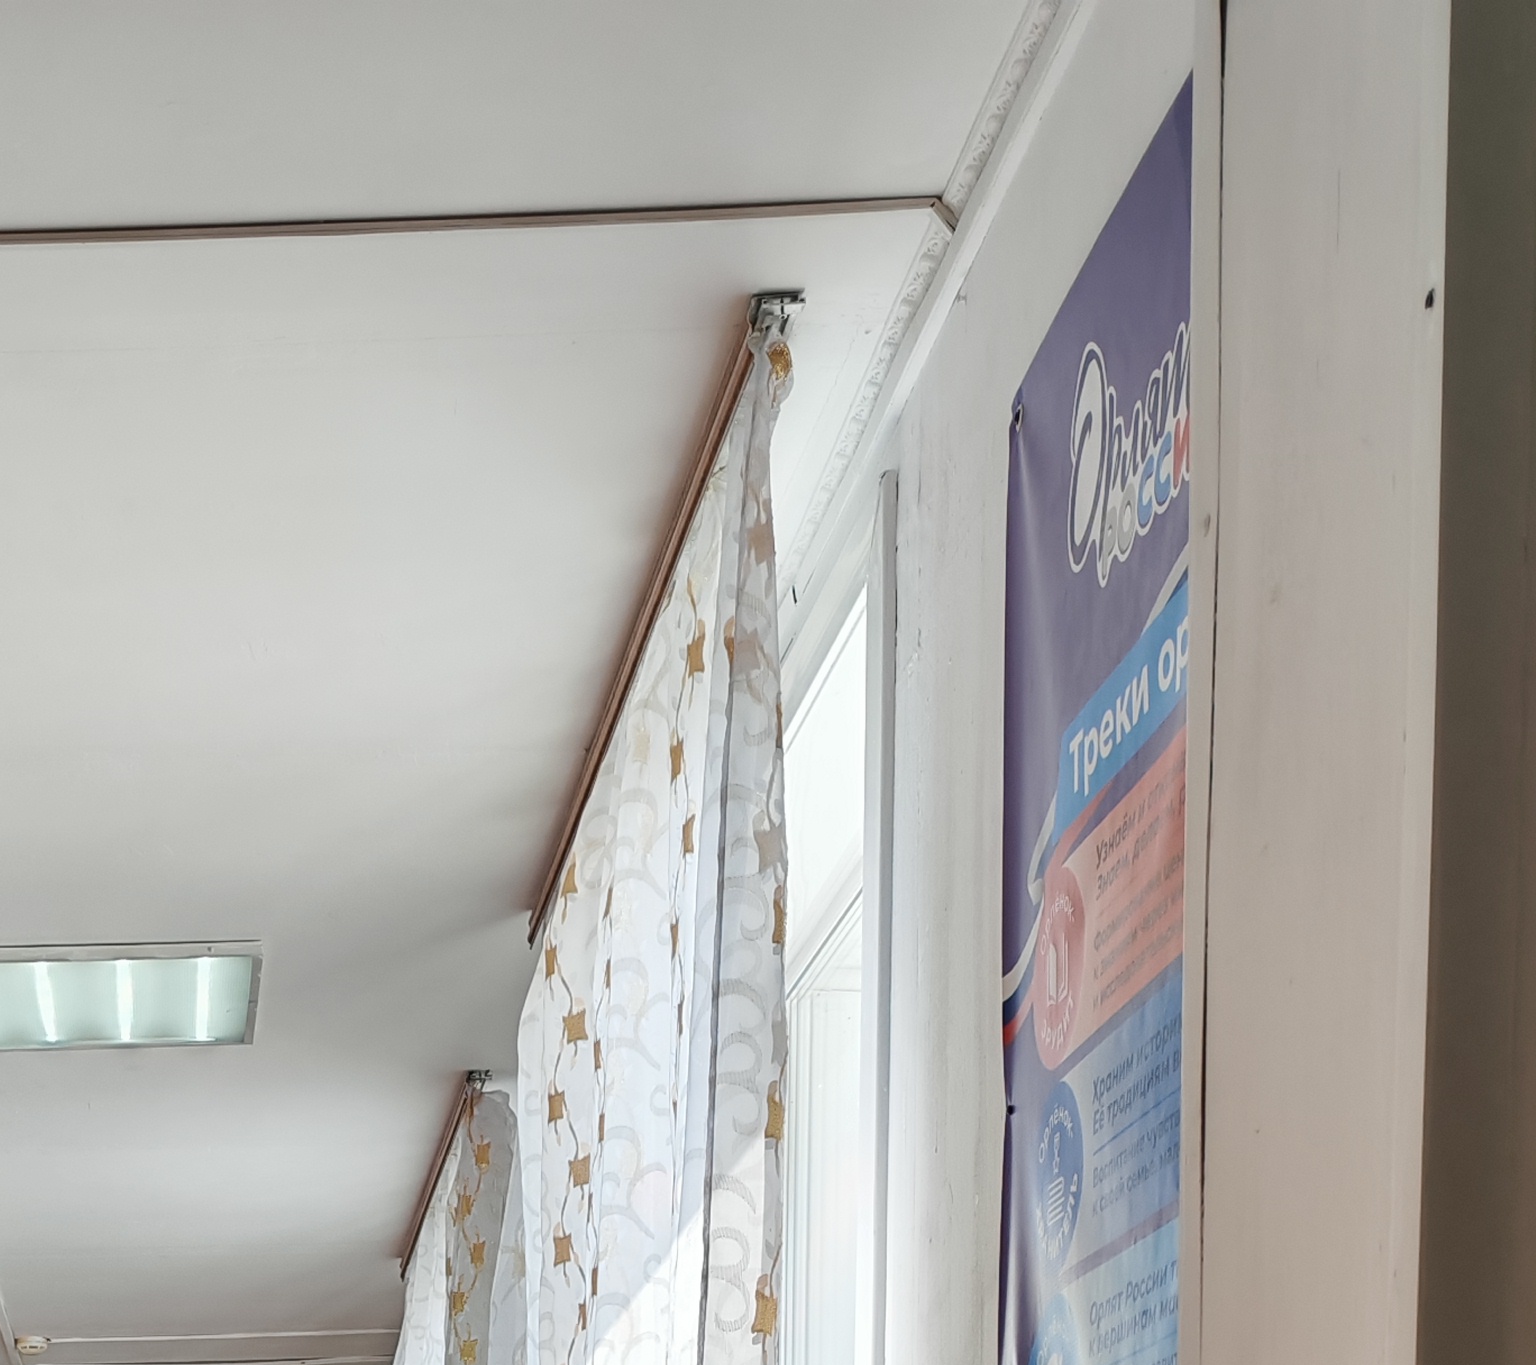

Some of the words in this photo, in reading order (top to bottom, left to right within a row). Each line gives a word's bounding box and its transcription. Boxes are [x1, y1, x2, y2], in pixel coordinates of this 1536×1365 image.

[1069, 663, 1150, 797] Треки
[1092, 1052, 1134, 1105] Храним
[1093, 1104, 1106, 1136] Её
[1107, 1057, 1170, 1127] традициям
[1090, 1289, 1124, 1331] Орлят
[1125, 1267, 1168, 1307] России
[1088, 1337, 1096, 1359] к
